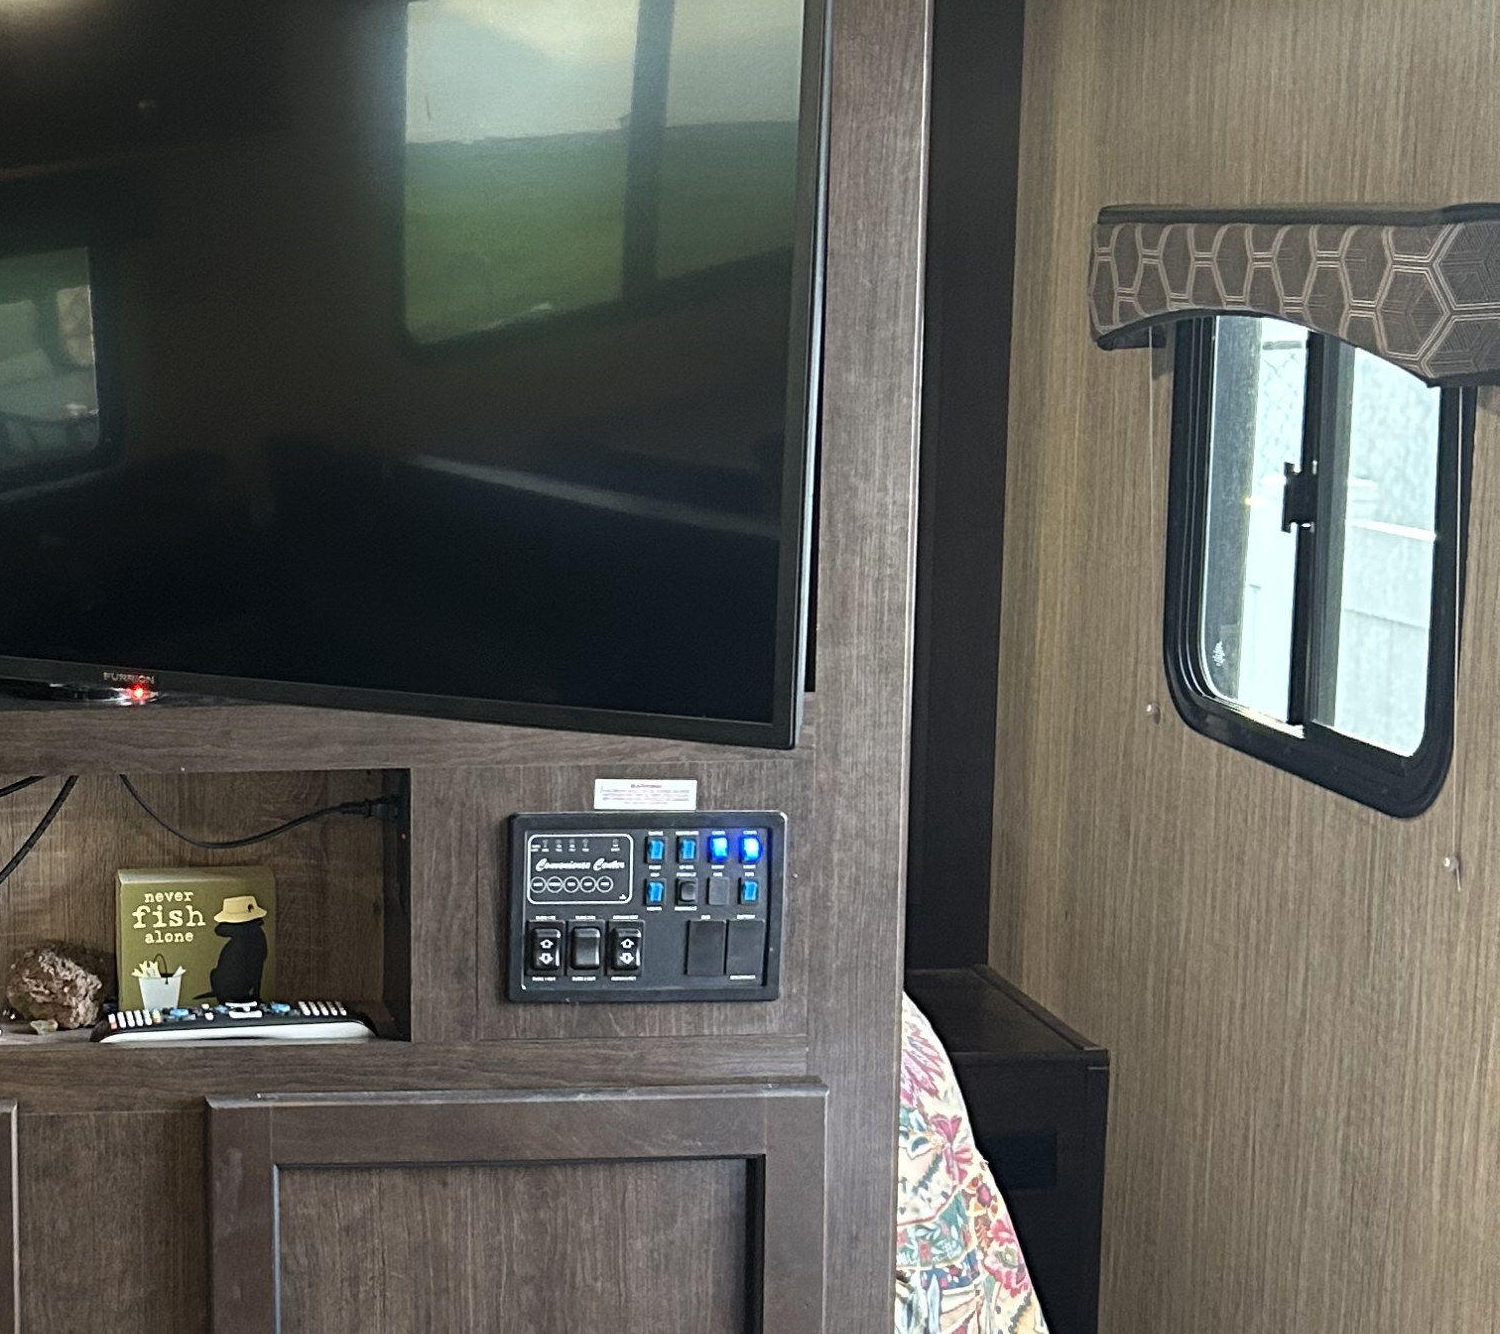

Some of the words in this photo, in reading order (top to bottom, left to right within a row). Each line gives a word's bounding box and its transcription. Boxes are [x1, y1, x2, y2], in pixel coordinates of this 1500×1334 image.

[103, 671, 155, 684] FURRION
[144, 891, 194, 903] never
[132, 904, 206, 929] fish
[144, 929, 194, 944] alone
